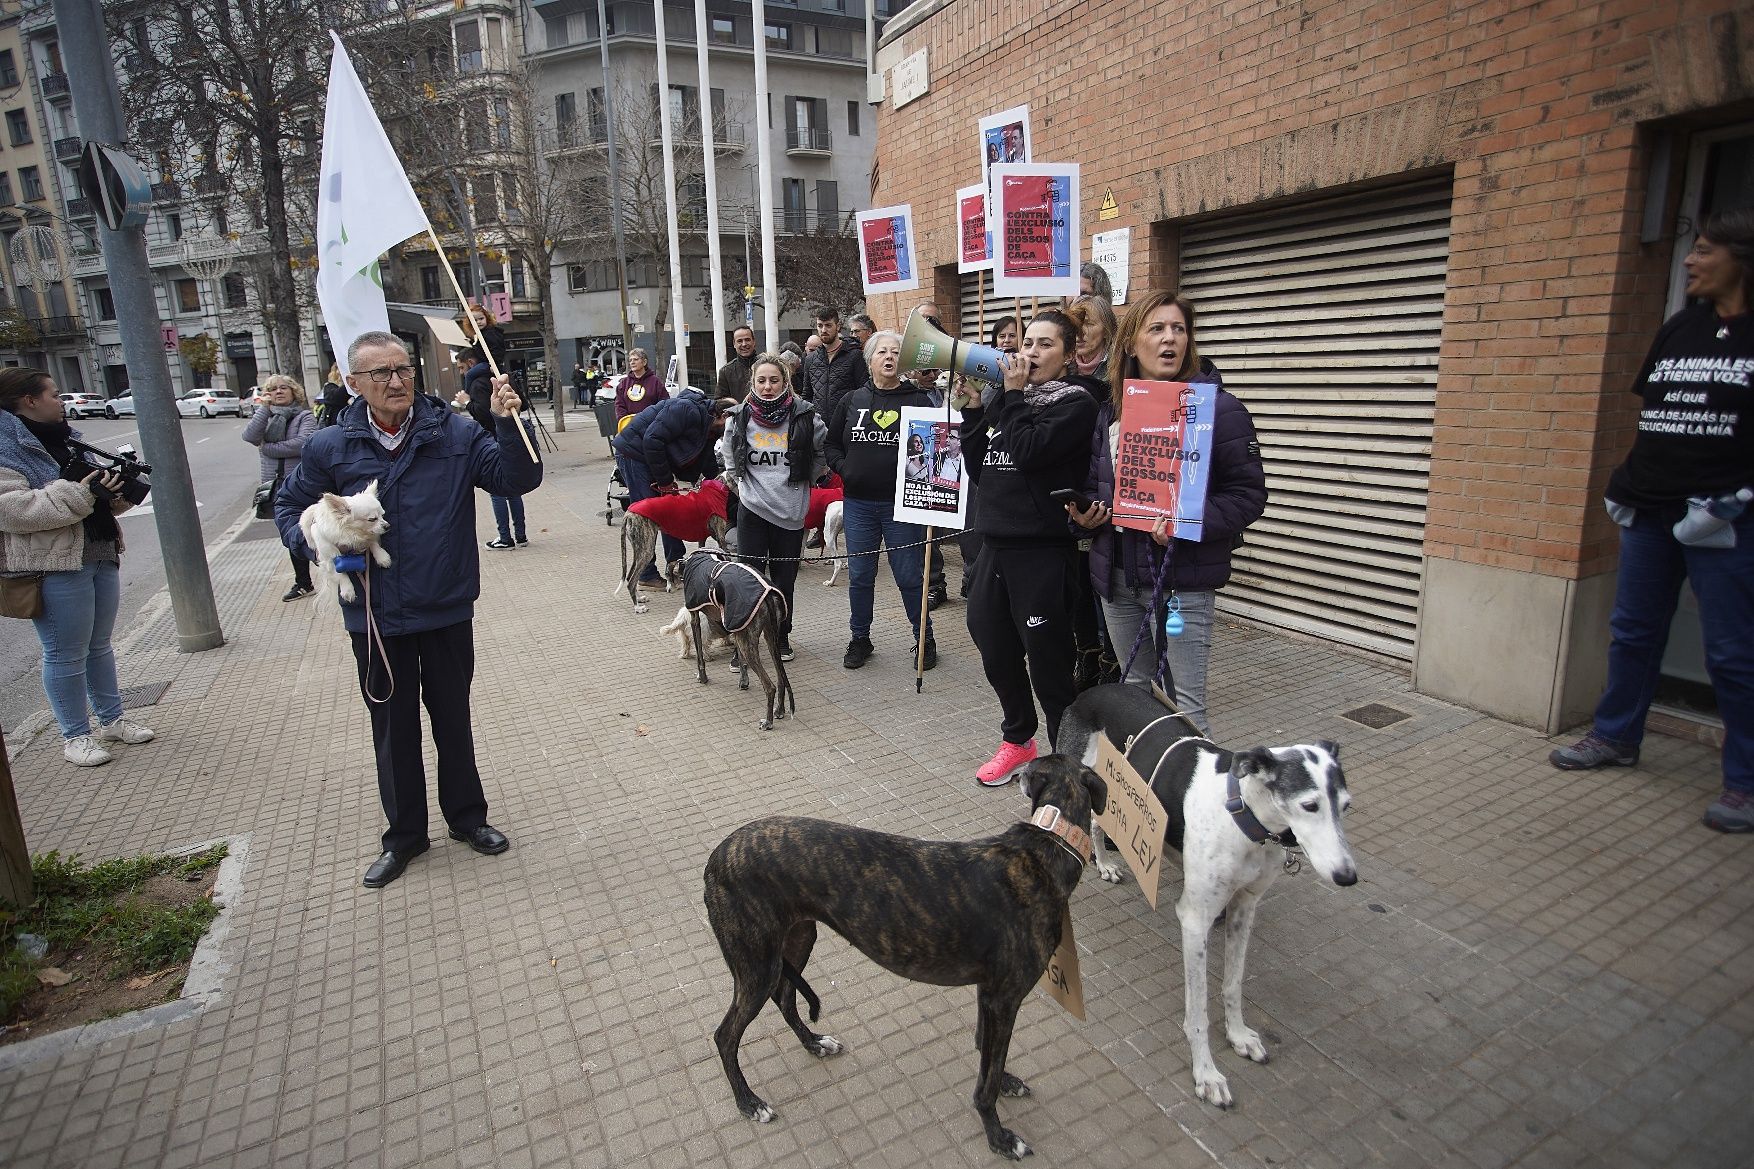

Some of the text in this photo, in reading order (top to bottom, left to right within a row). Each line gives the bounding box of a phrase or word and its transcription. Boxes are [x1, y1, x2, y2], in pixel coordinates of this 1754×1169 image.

[1007, 218, 1064, 227] L'EXCLUSIÓ
[1008, 252, 1036, 260] CAÇA
[1673, 358, 1754, 372] ANIMALES
[1663, 370, 1711, 381] TIENEN
[1664, 391, 1706, 403] ASÍ QUE
[852, 409, 869, 430] I
[1666, 411, 1716, 422] DEJARÁS
[1720, 414, 1737, 424] DE
[1639, 422, 1734, 436] ESCUCHAR LA MÍA
[851, 431, 900, 442] PACMA
[1124, 432, 1179, 448] CONTRA
[1122, 444, 1200, 462] L'EXCLUSIÓ
[1122, 454, 1156, 468] DELS
[1120, 466, 1176, 484] GOSSOS
[906, 482, 916, 490] NO
[1120, 477, 1138, 489] DE
[905, 488, 944, 498] EXCLUSIÓN
[1119, 488, 1156, 505] CAÇA
[1131, 824, 1156, 874] LEY
